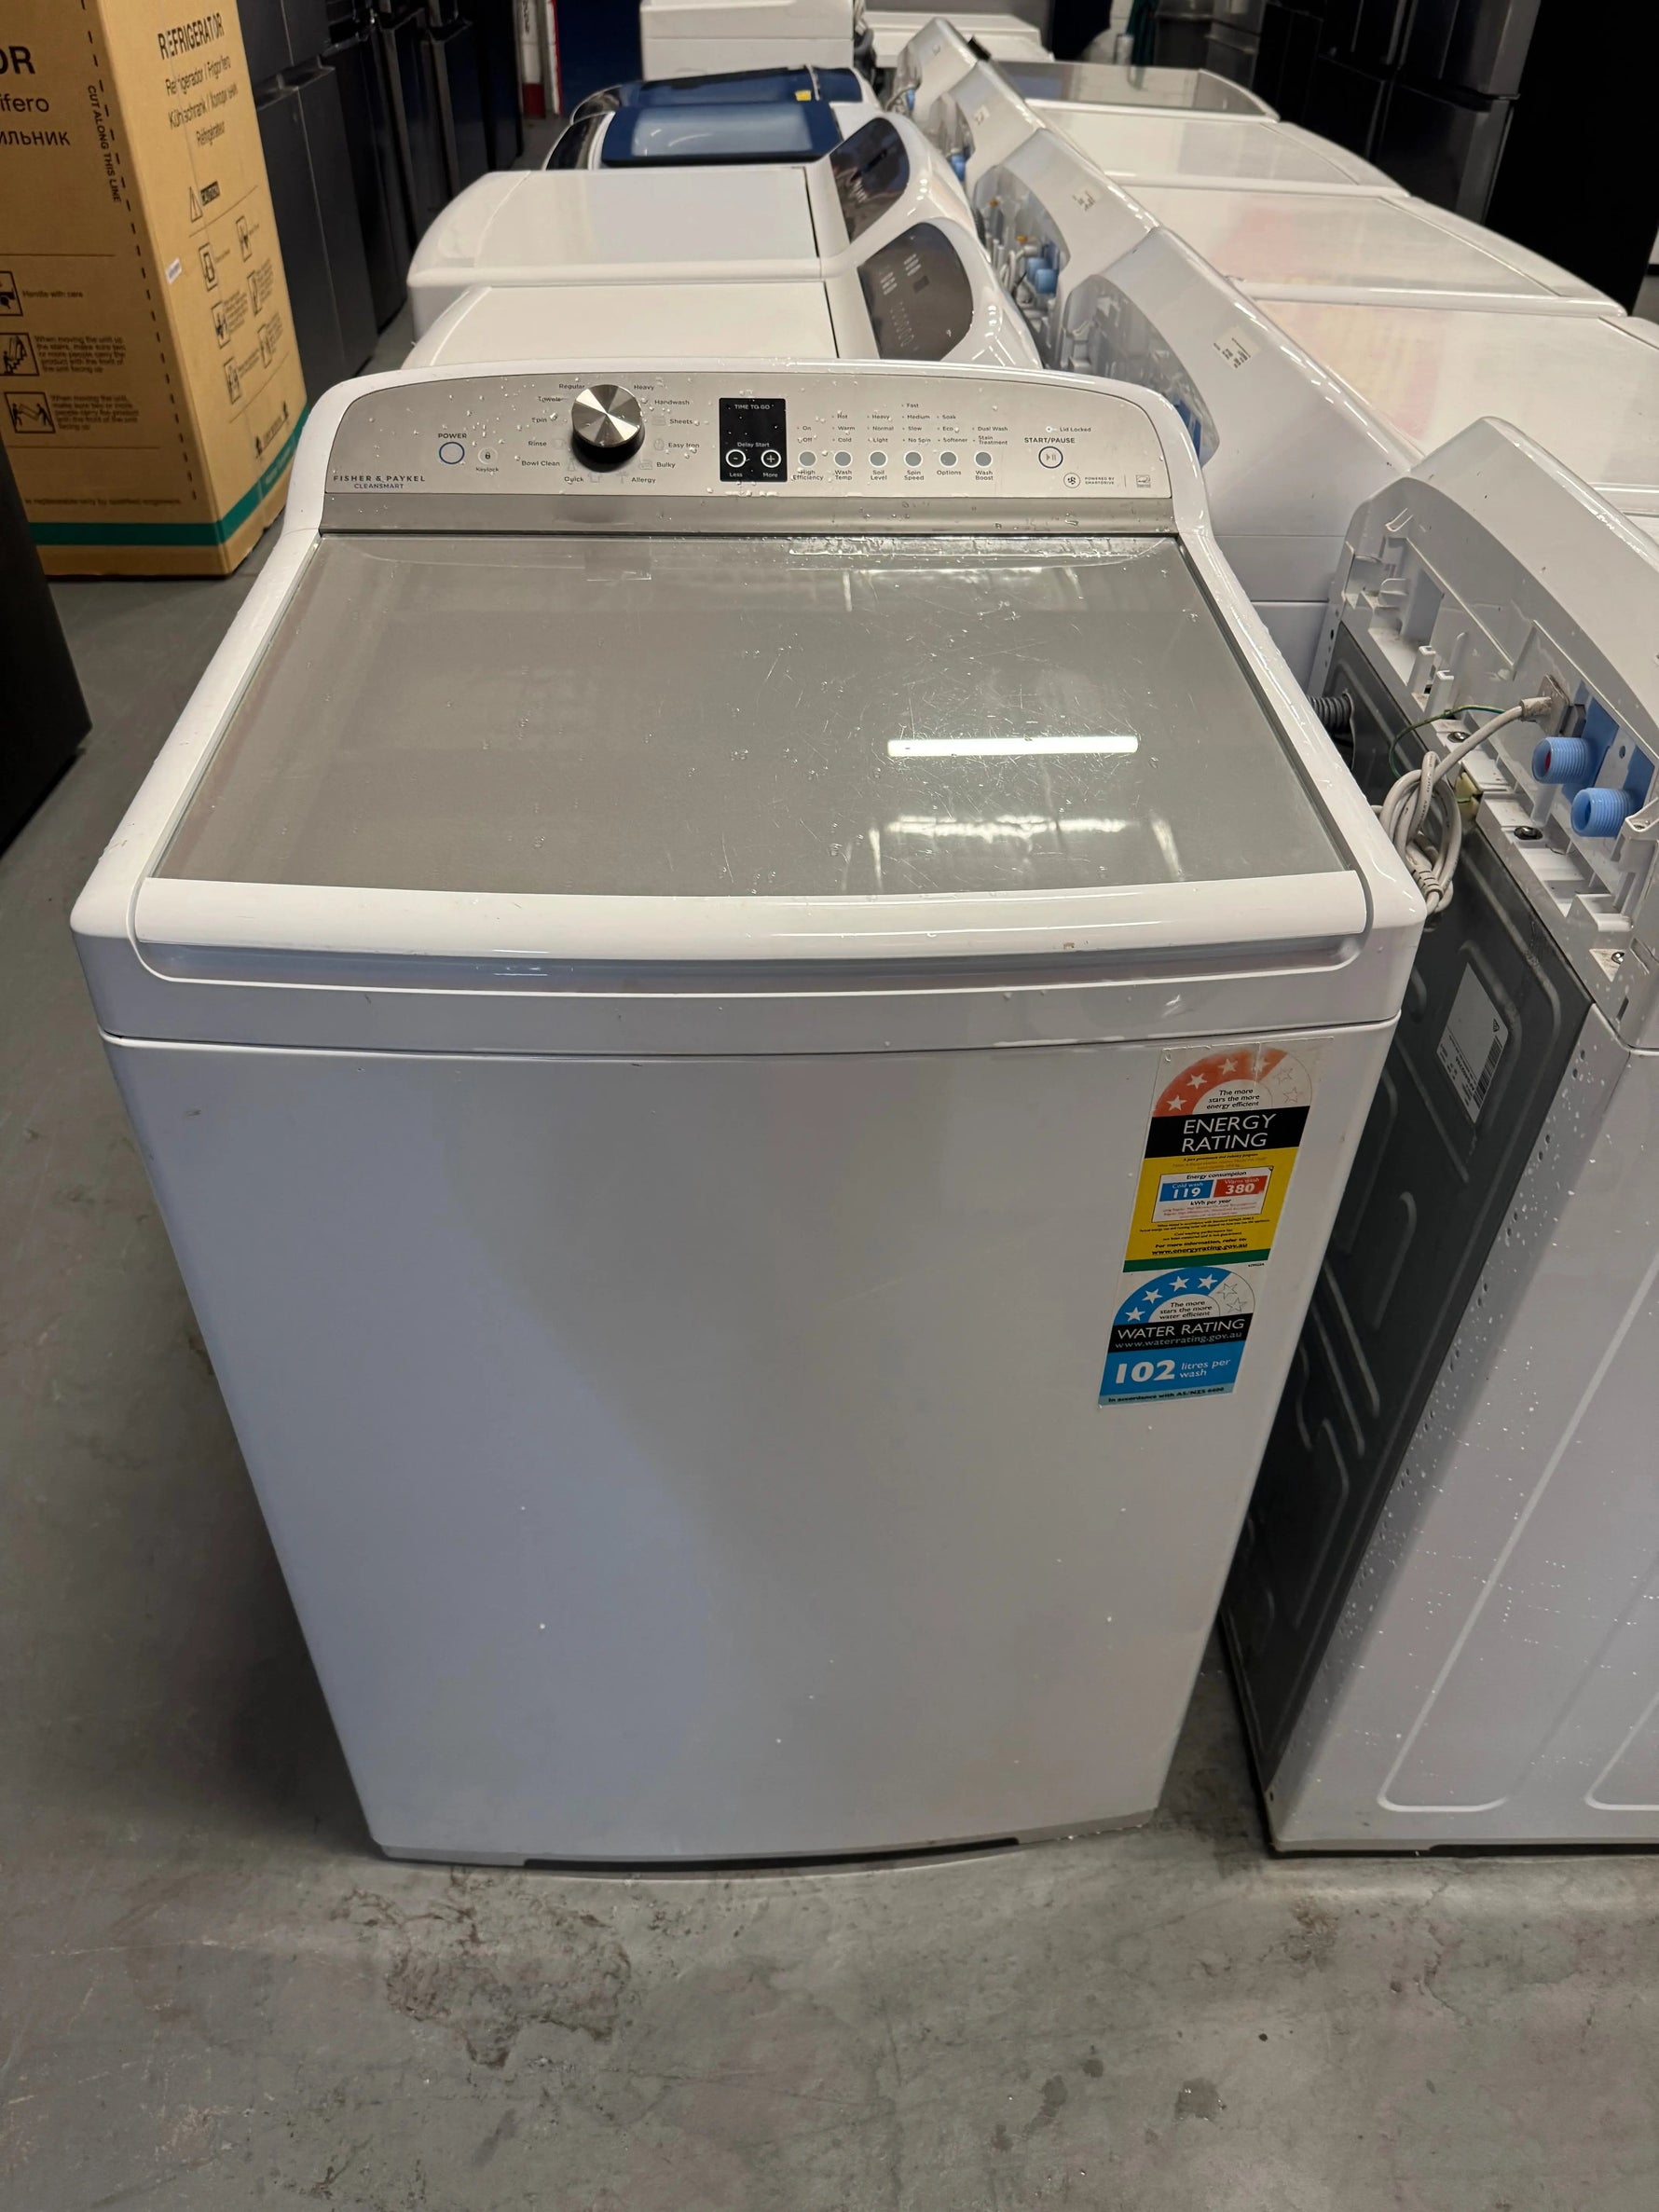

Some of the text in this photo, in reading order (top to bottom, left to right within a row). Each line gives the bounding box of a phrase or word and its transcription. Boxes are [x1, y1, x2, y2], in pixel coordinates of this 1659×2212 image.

[157, 12, 225, 60] REFRIGERATOR
[88, 85, 122, 203] CUT ALONG THIS LINE
[1183, 1113, 1277, 1135] ENERGY
[1181, 1132, 1268, 1153] RATING
[1173, 1188, 1200, 1199] 119
[1226, 1183, 1255, 1195] 380
[1152, 1244, 1248, 1256] www.energyrating.gov.au
[1117, 1318, 1246, 1340] WATER RATING
[1115, 1331, 1242, 1349] www.waterrating.gov.au
[1116, 1358, 1231, 1384] 102 litres per
[1179, 1369, 1207, 1379] wash
